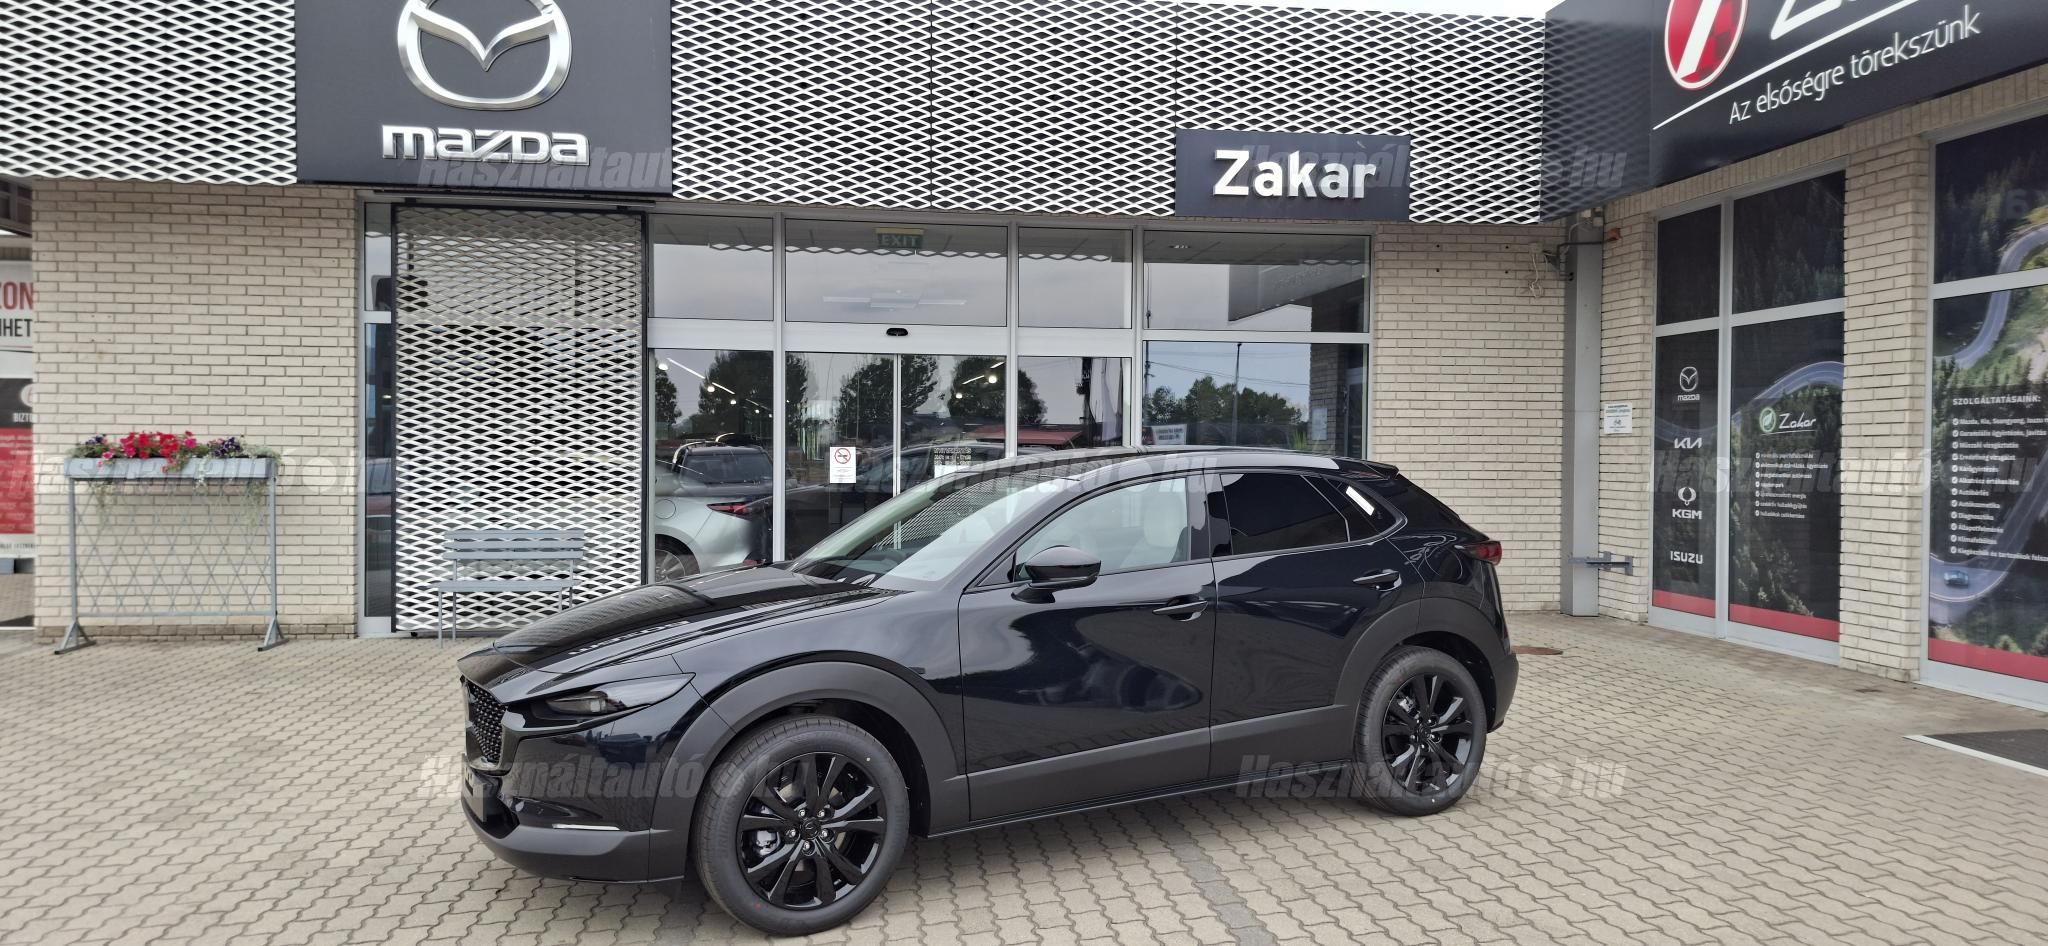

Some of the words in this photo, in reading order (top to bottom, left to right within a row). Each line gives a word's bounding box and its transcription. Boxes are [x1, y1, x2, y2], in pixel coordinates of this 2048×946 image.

[1729, 101, 1751, 124] Az
[1756, 64, 1845, 114] elsőségre
[1850, 4, 1982, 79] törekszünk
[1212, 148, 1377, 199] Zakar
[881, 234, 921, 248] EXIT
[0, 282, 34, 310] ON
[0, 318, 33, 337] HET
[1779, 412, 1817, 429] Zakar
[1674, 437, 1702, 449] KIA
[1672, 509, 1702, 520] KGM
[1670, 550, 1704, 565] ISUZU
